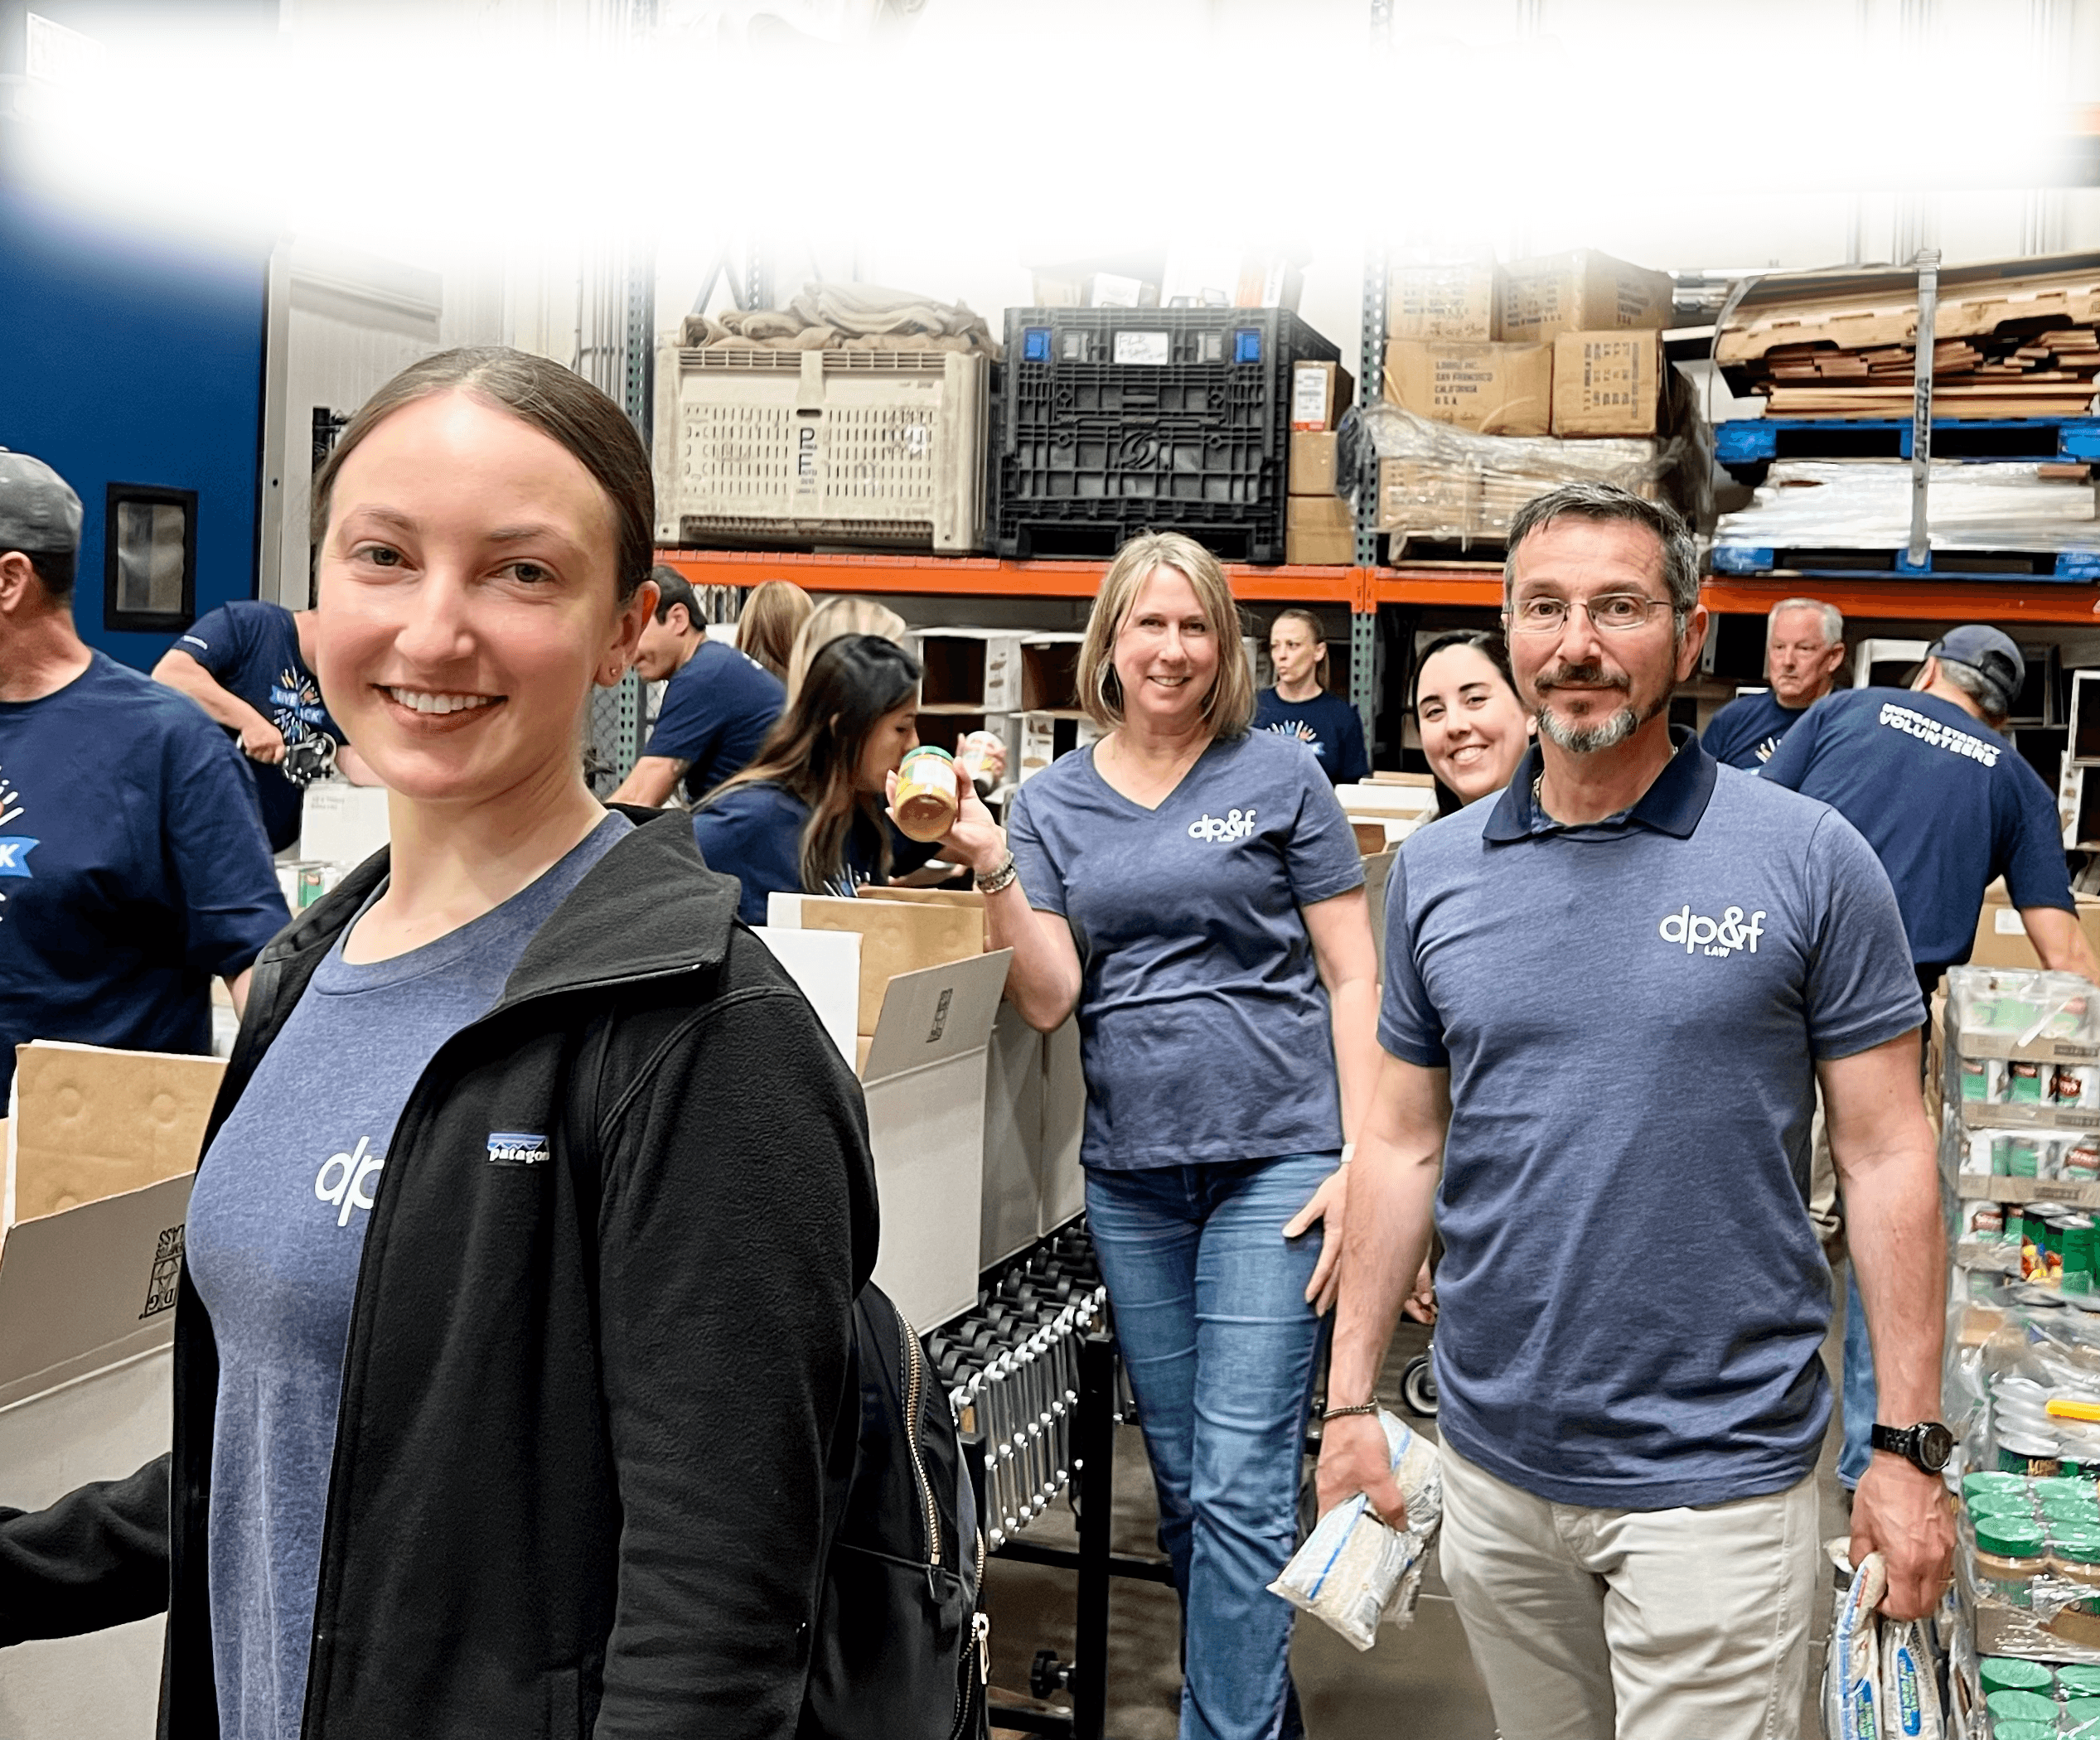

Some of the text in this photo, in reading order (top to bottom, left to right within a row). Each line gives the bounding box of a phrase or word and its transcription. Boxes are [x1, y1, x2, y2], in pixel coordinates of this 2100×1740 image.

[1880, 711, 1997, 768] VOLUNTEERS
[1188, 808, 1256, 843] dp&f
[1659, 904, 1767, 955] dp&f
[1704, 945, 1731, 958] LAW
